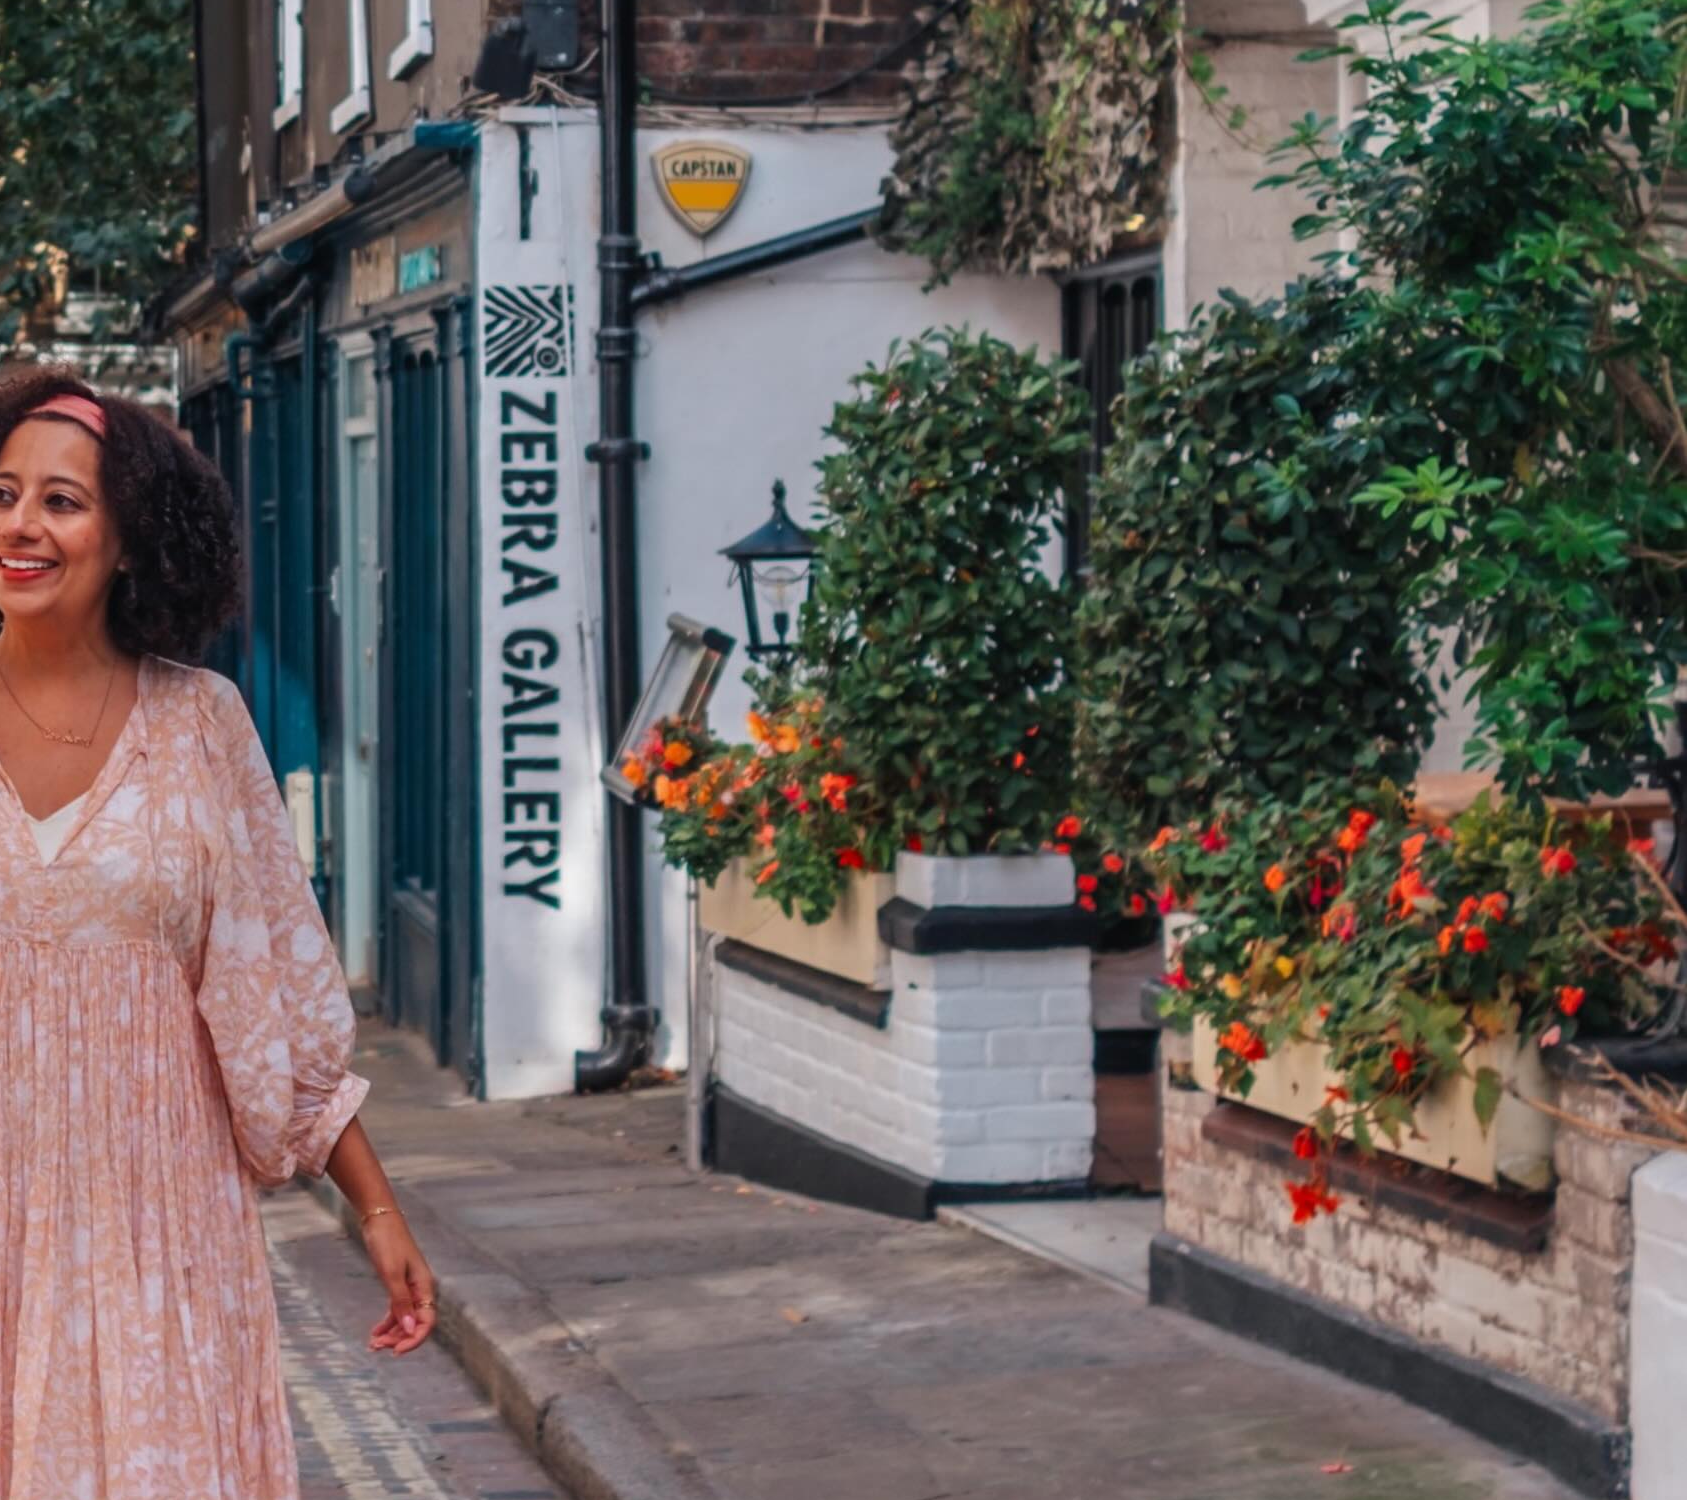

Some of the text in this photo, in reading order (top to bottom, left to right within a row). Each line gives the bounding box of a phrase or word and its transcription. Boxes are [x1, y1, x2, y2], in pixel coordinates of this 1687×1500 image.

[672, 160, 737, 177] CAPSTAN
[500, 390, 561, 909] ZEBRA GALLERY
